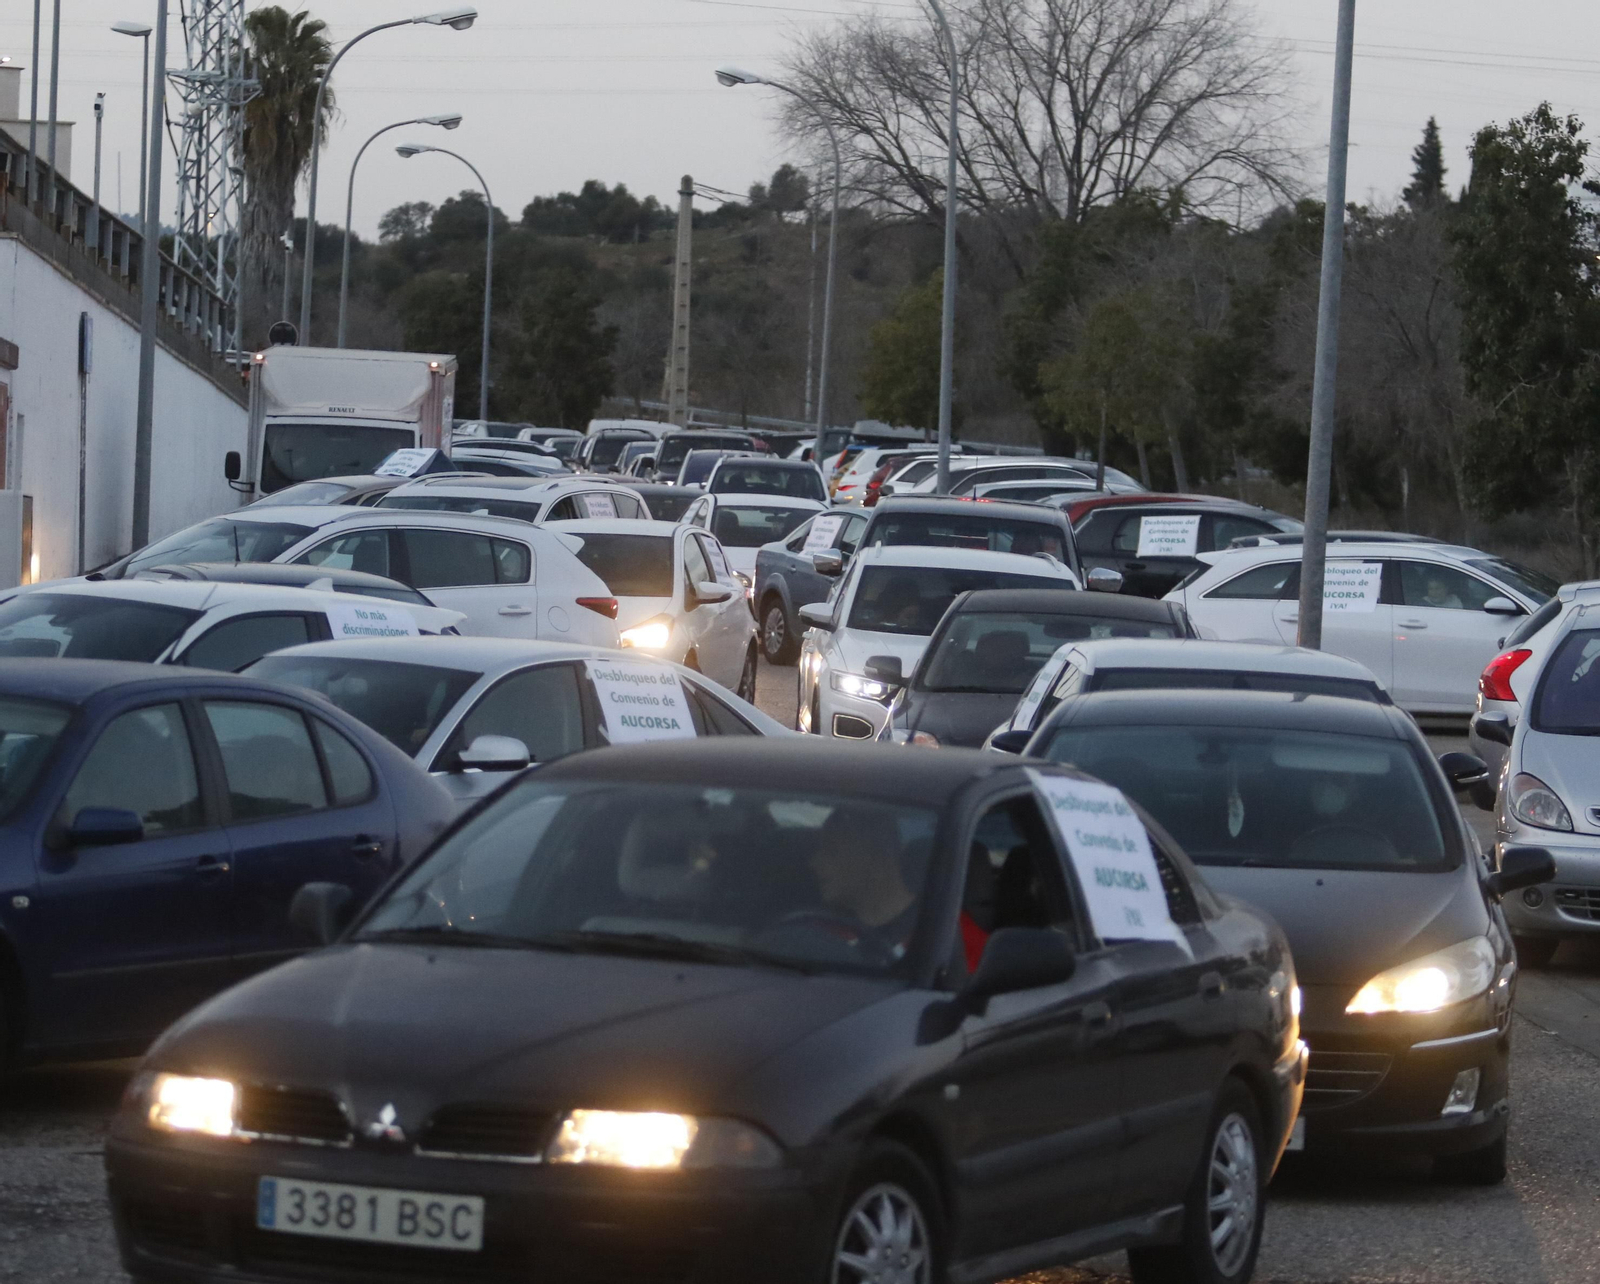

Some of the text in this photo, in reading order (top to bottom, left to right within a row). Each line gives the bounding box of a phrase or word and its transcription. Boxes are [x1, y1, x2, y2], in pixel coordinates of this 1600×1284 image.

[1323, 567, 1378, 576] sbloqueo del
[1323, 579, 1369, 587] onvenio de
[1323, 591, 1365, 599] UCORSA
[354, 608, 387, 621] No más
[593, 668, 677, 686] Desbloqueo del
[610, 691, 676, 707] Convenio de
[620, 714, 681, 730] AUCORSA
[285, 1187, 473, 1242] 3381 BSC
